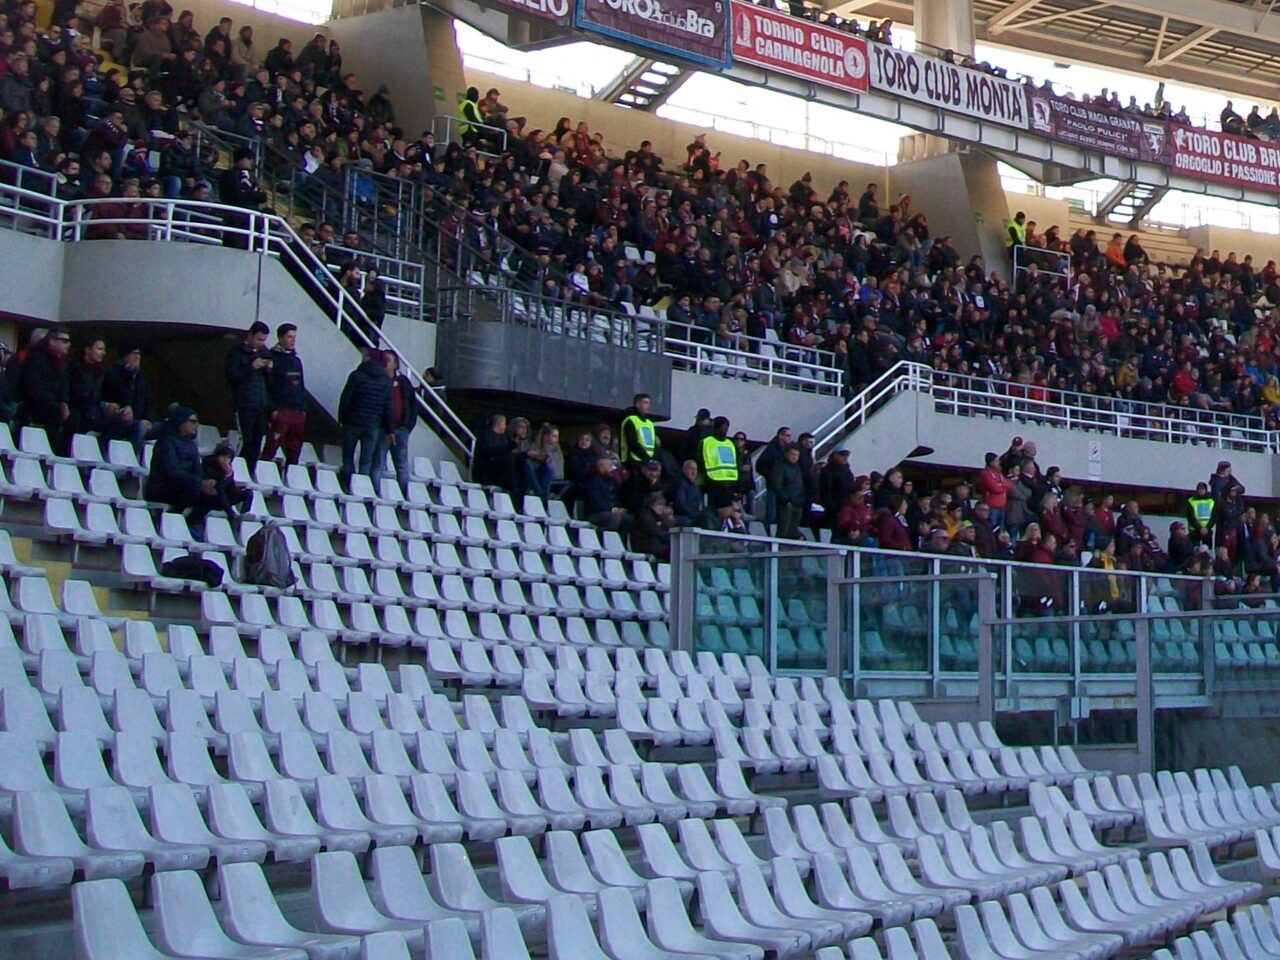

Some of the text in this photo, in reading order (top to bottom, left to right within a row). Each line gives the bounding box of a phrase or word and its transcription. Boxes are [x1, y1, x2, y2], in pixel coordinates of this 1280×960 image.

[754, 15, 843, 57] TORINO CLUB
[755, 37, 845, 78] CARMAGNOLA
[873, 42, 919, 95] TORO
[924, 60, 961, 106] CLUB
[1050, 100, 1069, 115] TORO
[1069, 104, 1088, 120] CLUB
[1109, 114, 1141, 133] GRANATA
[1185, 131, 1220, 157] TORO
[1223, 139, 1256, 164] CLUB
[1175, 153, 1221, 176] ORGOGLIO
[1223, 162, 1230, 177] E
[1231, 164, 1276, 186] PASSIONE
